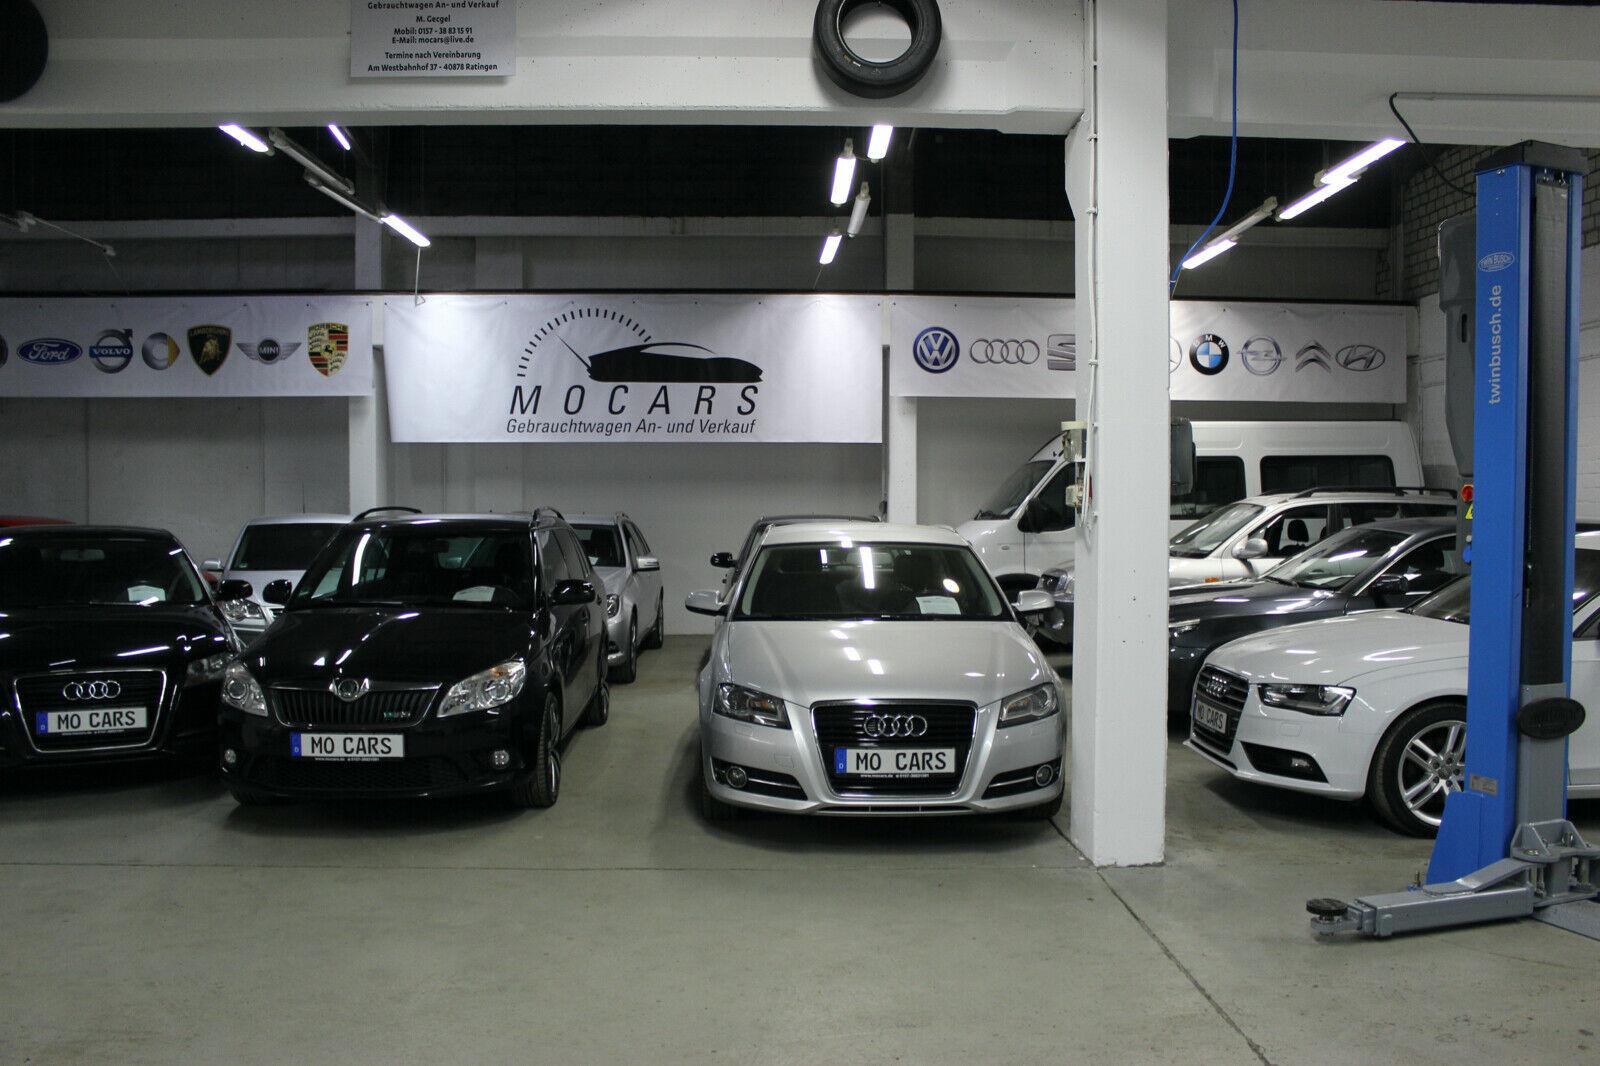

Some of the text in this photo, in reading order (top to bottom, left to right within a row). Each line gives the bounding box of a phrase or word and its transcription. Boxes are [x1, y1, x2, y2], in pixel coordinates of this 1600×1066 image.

[368, 1, 434, 10] Gebrauchtwagen
[469, 0, 499, 8] Verkauf
[394, 27, 417, 35] Mobil:
[418, 27, 433, 35] 0157
[439, 27, 447, 35] 38
[457, 27, 464, 35] 15
[465, 27, 473, 35] 91
[418, 36, 474, 45] mocars@live.de
[433, 51, 481, 60] Vereinbarung
[368, 64, 380, 72] Am
[381, 63, 429, 71] Westbahnhof
[430, 63, 438, 71] 37
[443, 63, 464, 71] 40878
[466, 63, 498, 72] Ratingen
[29, 342, 70, 360] Ford
[260, 346, 279, 354] MINI
[1488, 284, 1502, 405] twinbusch.de
[92, 348, 131, 356] VOLVO
[510, 384, 759, 416] MOCARS
[506, 418, 757, 436] Gebrauchtwagen An- und Verkauf
[58, 711, 136, 730] MO CARS
[311, 737, 392, 755] MO CARS
[856, 752, 947, 771] MO CARS
